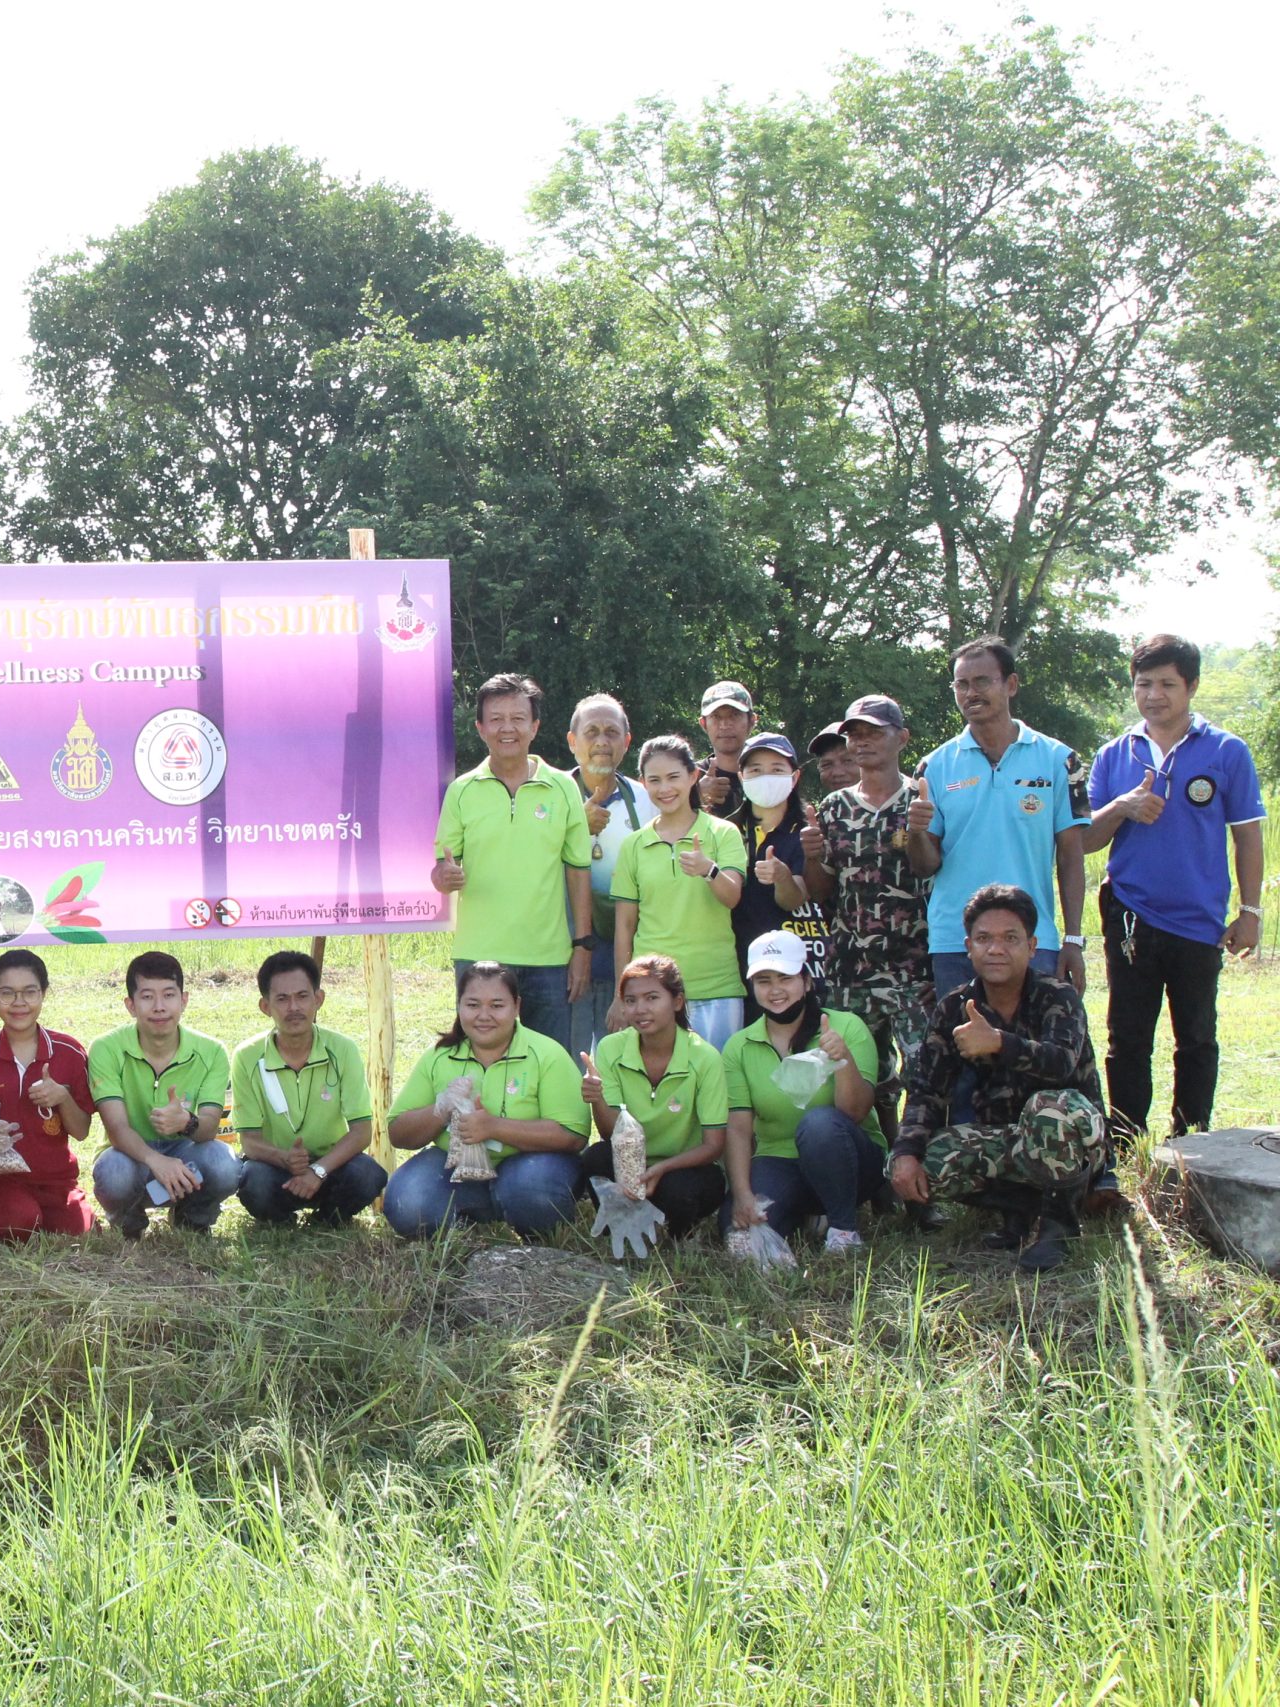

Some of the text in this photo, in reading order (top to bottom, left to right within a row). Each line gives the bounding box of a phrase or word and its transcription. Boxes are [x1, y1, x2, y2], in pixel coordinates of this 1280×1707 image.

[90, 660, 206, 687] Campus
[207, 813, 363, 844] วิทยาเขตตรัง
